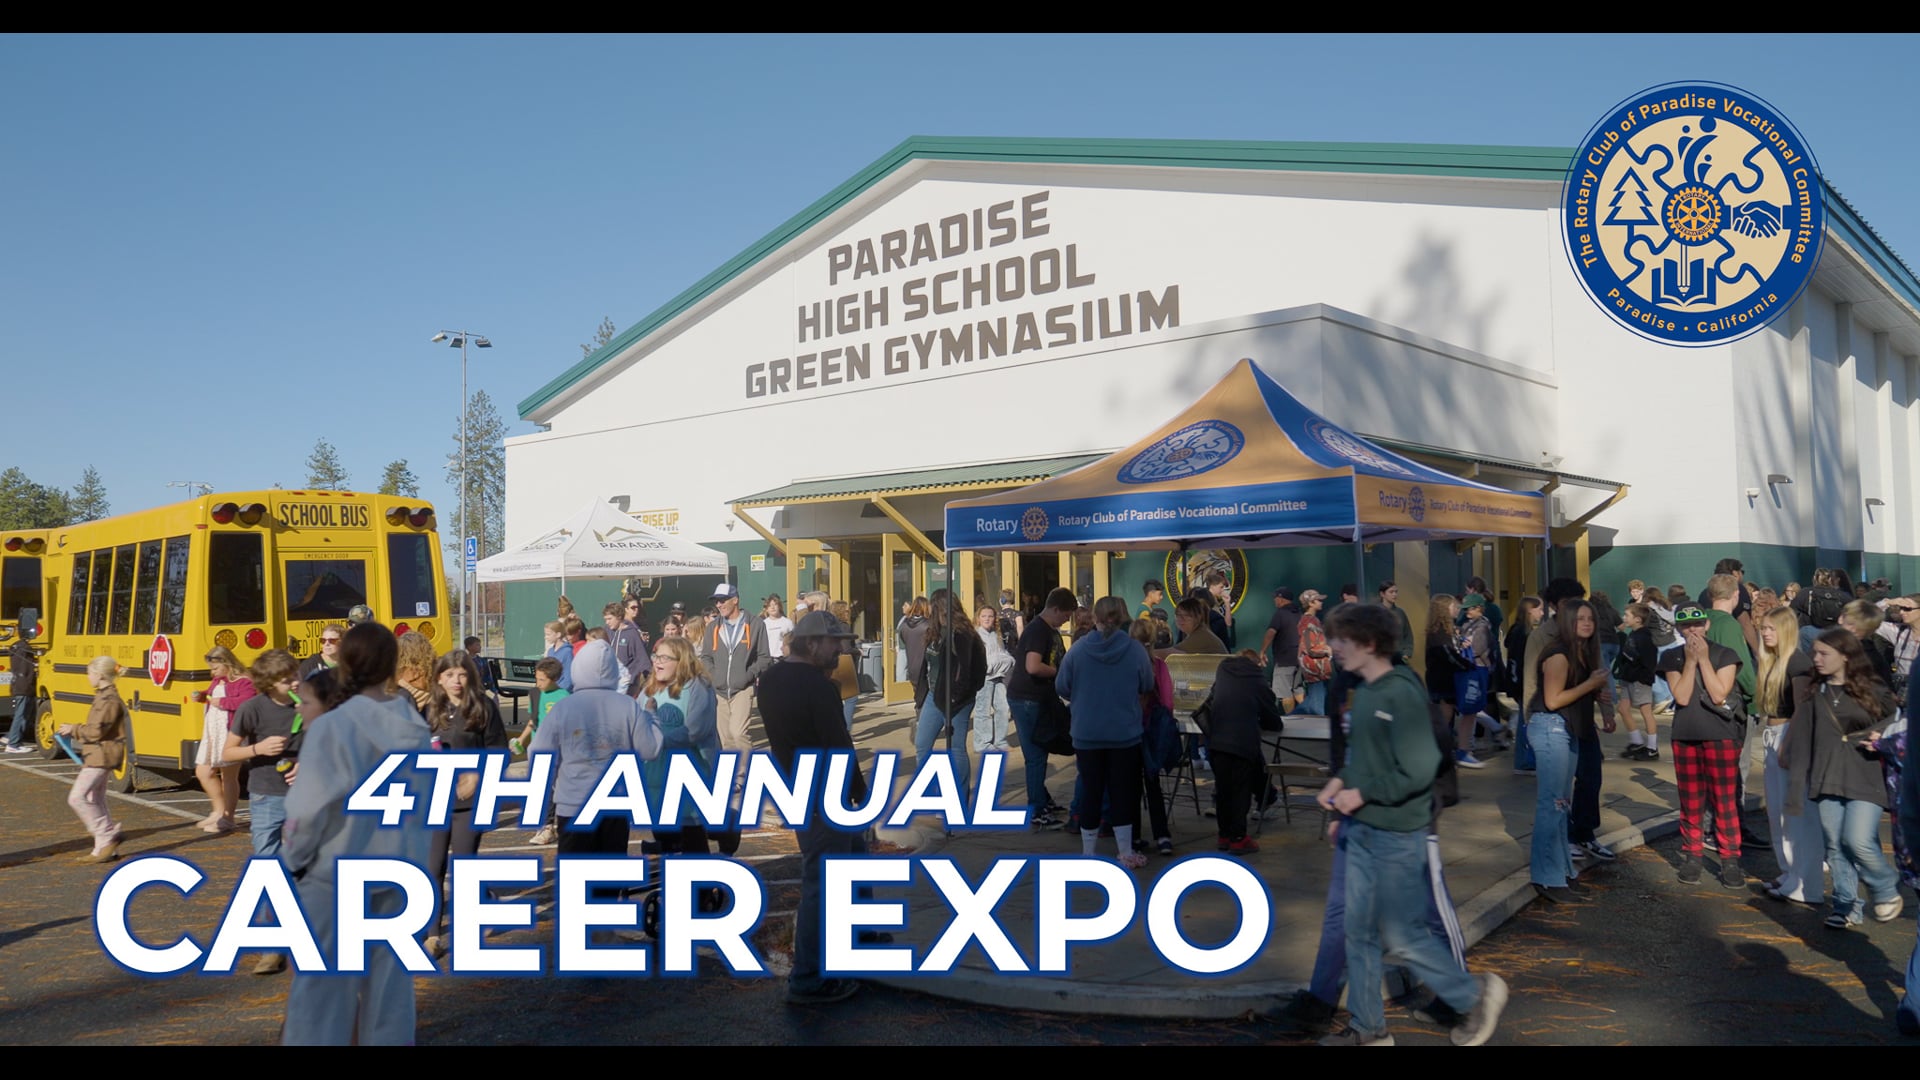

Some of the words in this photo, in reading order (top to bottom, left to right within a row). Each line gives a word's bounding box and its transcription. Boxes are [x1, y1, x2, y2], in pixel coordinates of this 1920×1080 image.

[828, 190, 1050, 286] PARADISE
[798, 286, 889, 343] HIGH
[902, 243, 1096, 321] SCHOOL
[745, 343, 871, 399] GREEN
[884, 284, 1180, 376] GYMNASIUM
[1378, 490, 1408, 513] Rotary
[280, 504, 338, 527] SCHOOL
[340, 505, 368, 527] BUS
[665, 511, 680, 526] UP
[1058, 515, 1090, 528] Rotary
[1092, 512, 1116, 524] Club
[1117, 509, 1129, 522] of
[1129, 507, 1177, 521] Paradise
[1178, 503, 1239, 518] Vocational
[1240, 499, 1308, 515] Committee
[976, 518, 1018, 535] Rotary
[599, 541, 670, 549] PARADISE
[581, 560, 614, 568] Paradise
[615, 559, 655, 568] Recreation
[151, 650, 169, 670] STOP
